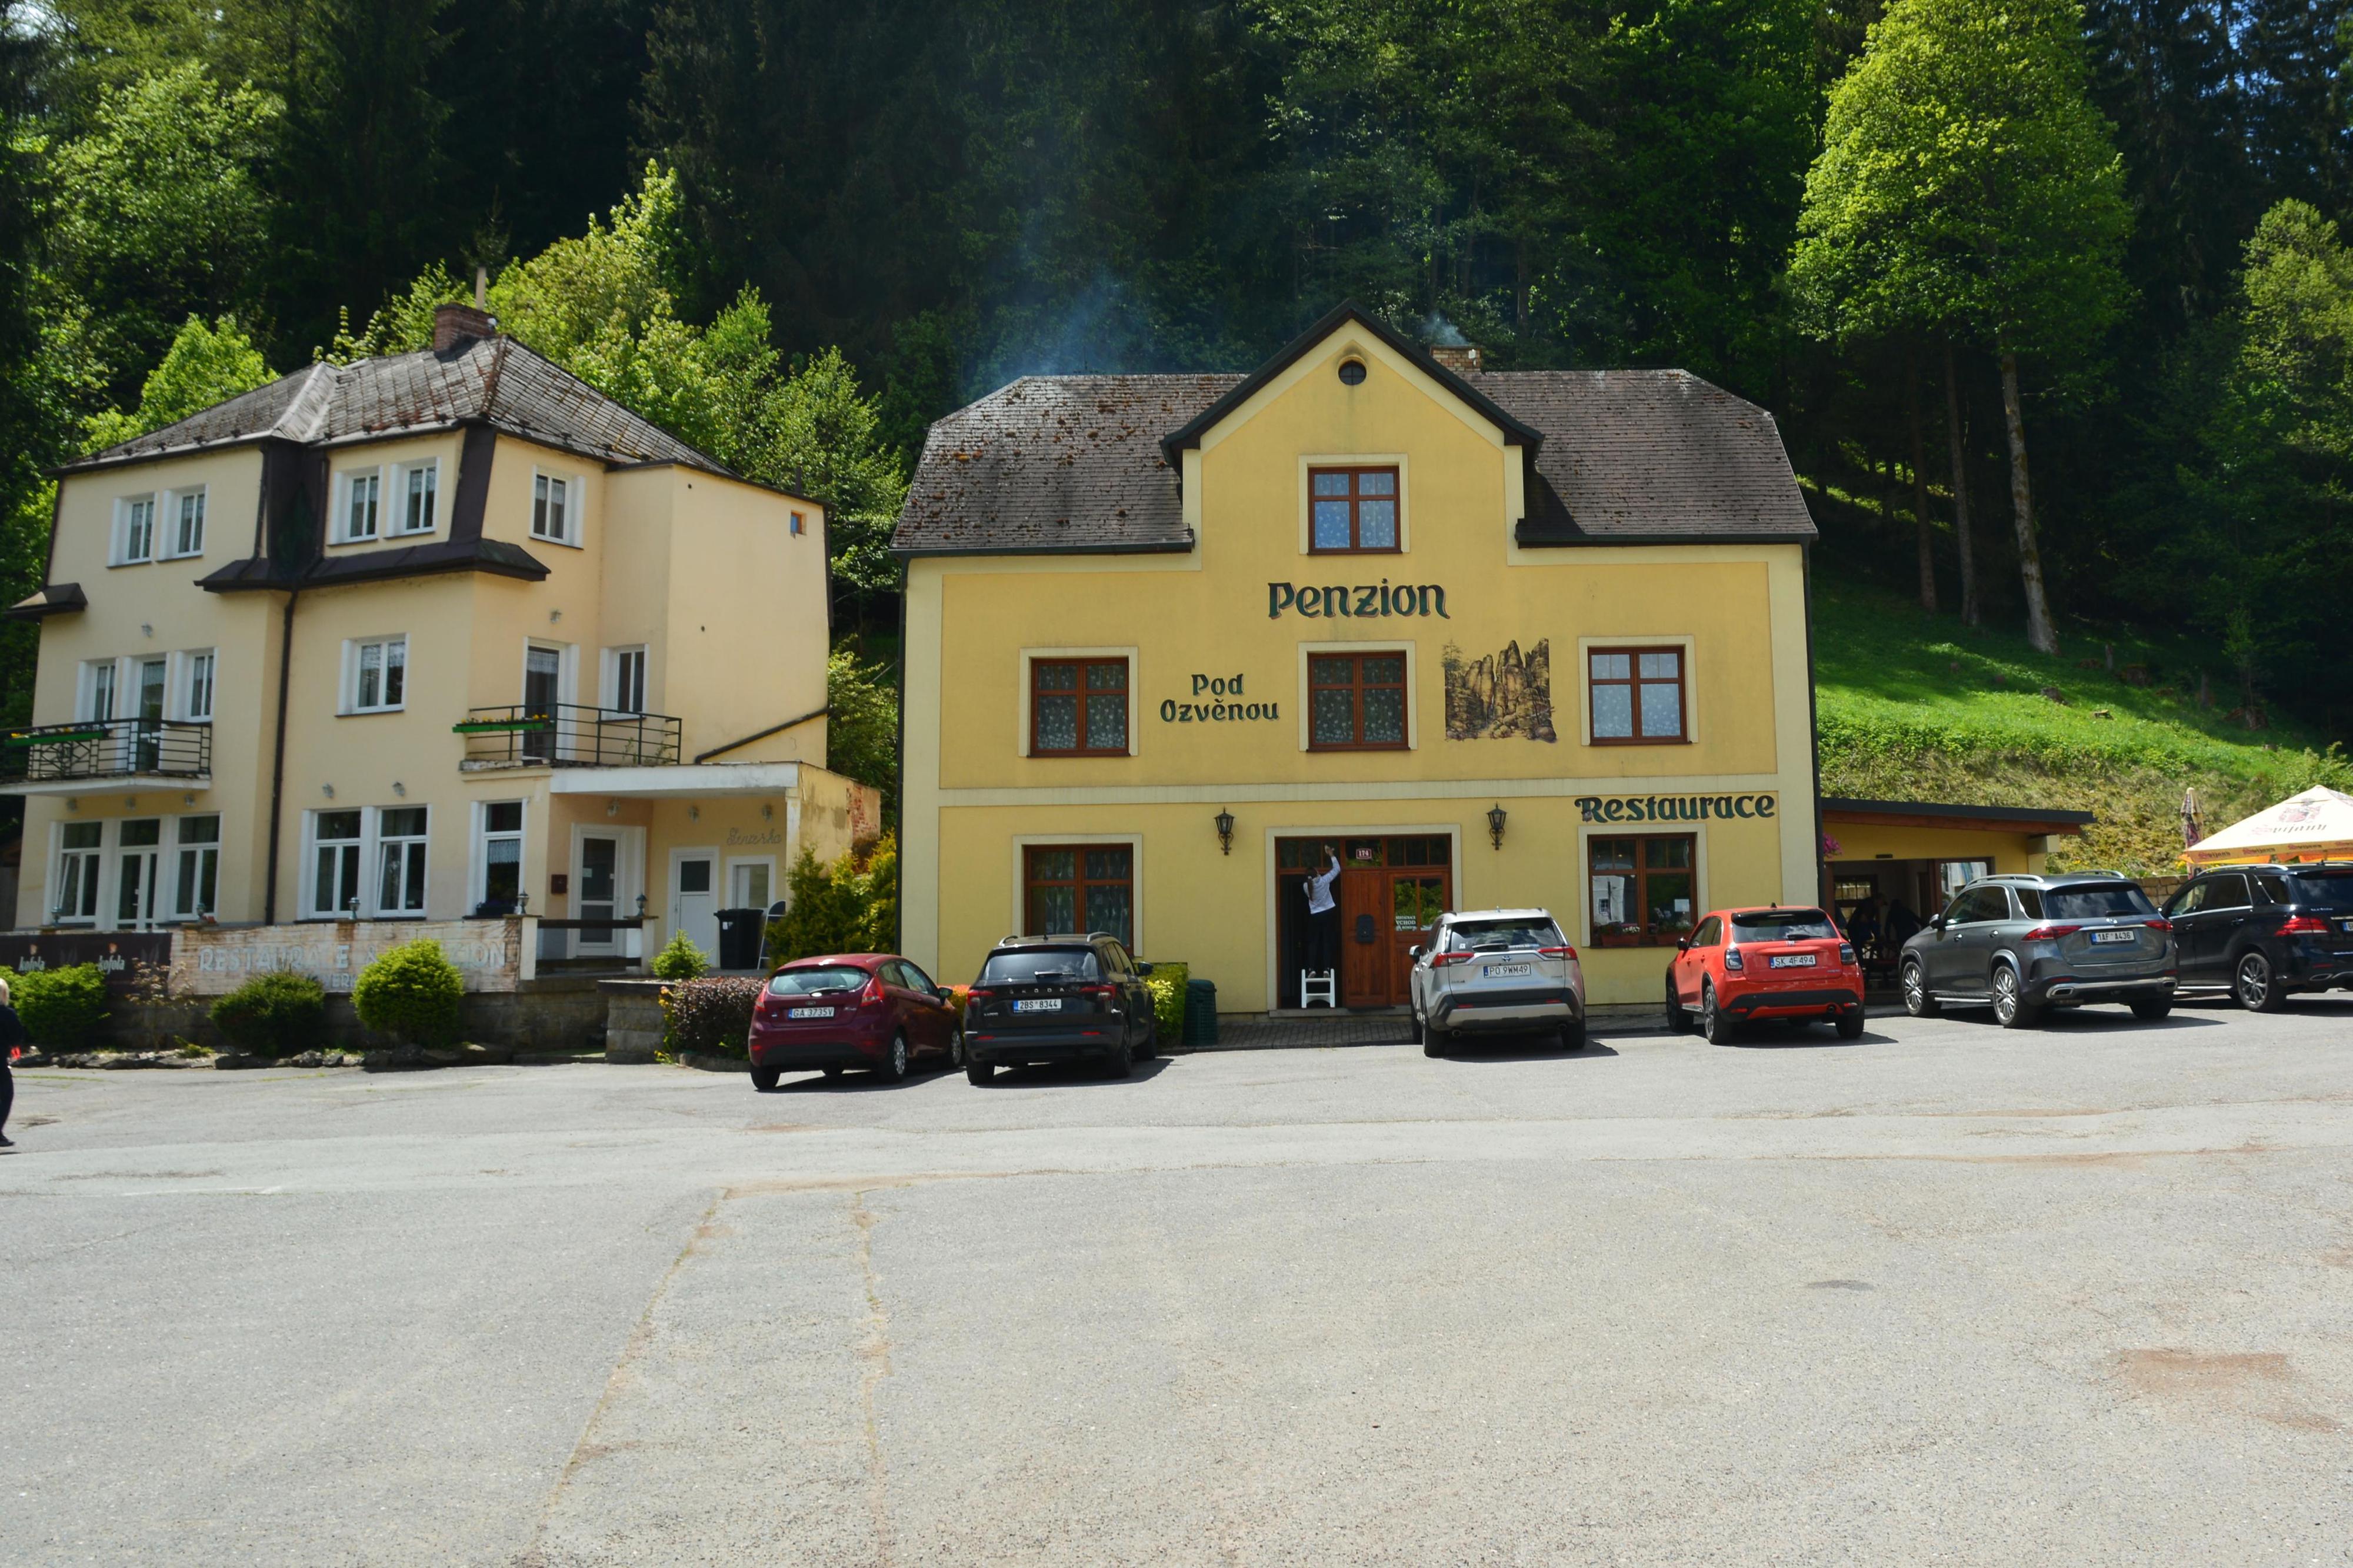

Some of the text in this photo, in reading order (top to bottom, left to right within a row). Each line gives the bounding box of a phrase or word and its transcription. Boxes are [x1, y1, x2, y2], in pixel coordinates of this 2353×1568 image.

[1268, 578, 1450, 619] Penzion
[1191, 673, 1244, 696] Pod
[1160, 698, 1279, 723] Ozvěnou
[1574, 795, 1775, 823] Restaurace
[98, 955, 125, 975] kofola
[1489, 965, 1528, 975] PO 9WM49
[1775, 957, 1786, 965] SK
[794, 1008, 833, 1017] GA 3735V
